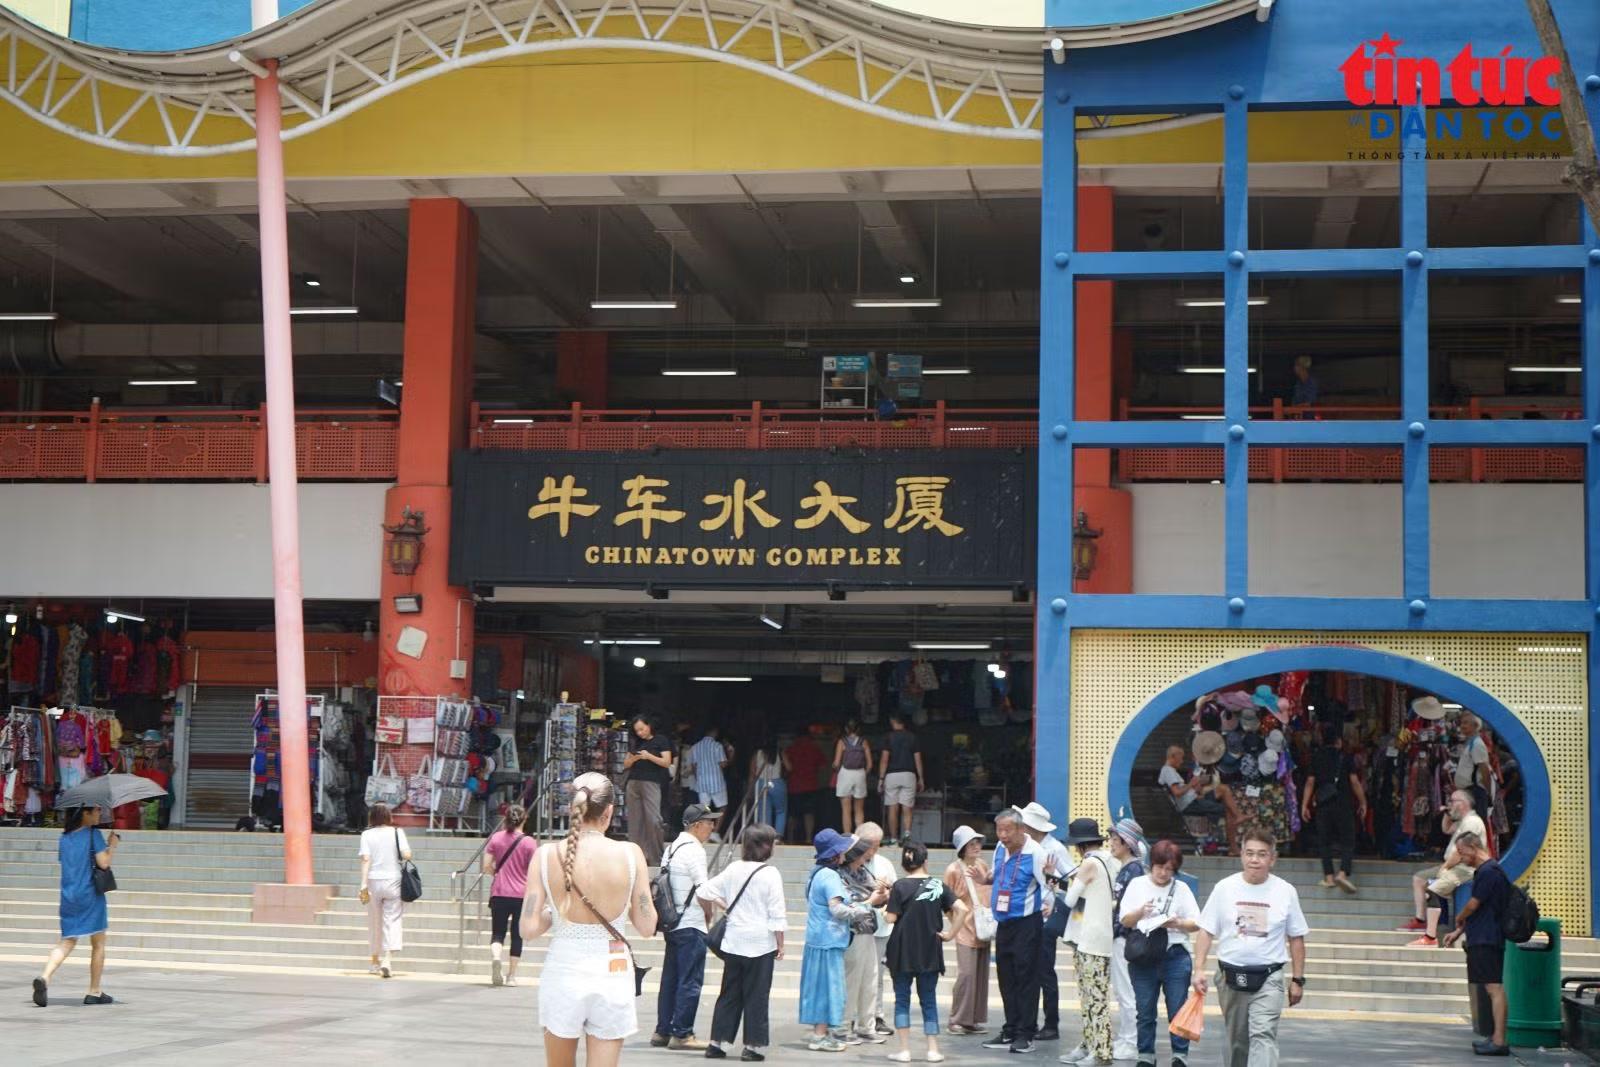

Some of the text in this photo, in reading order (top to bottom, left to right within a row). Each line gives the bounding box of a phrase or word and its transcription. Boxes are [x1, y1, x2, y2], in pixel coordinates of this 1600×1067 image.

[528, 474, 965, 540] 牛车水大厦
[584, 545, 902, 567] CHINATOWN COMPLEX
